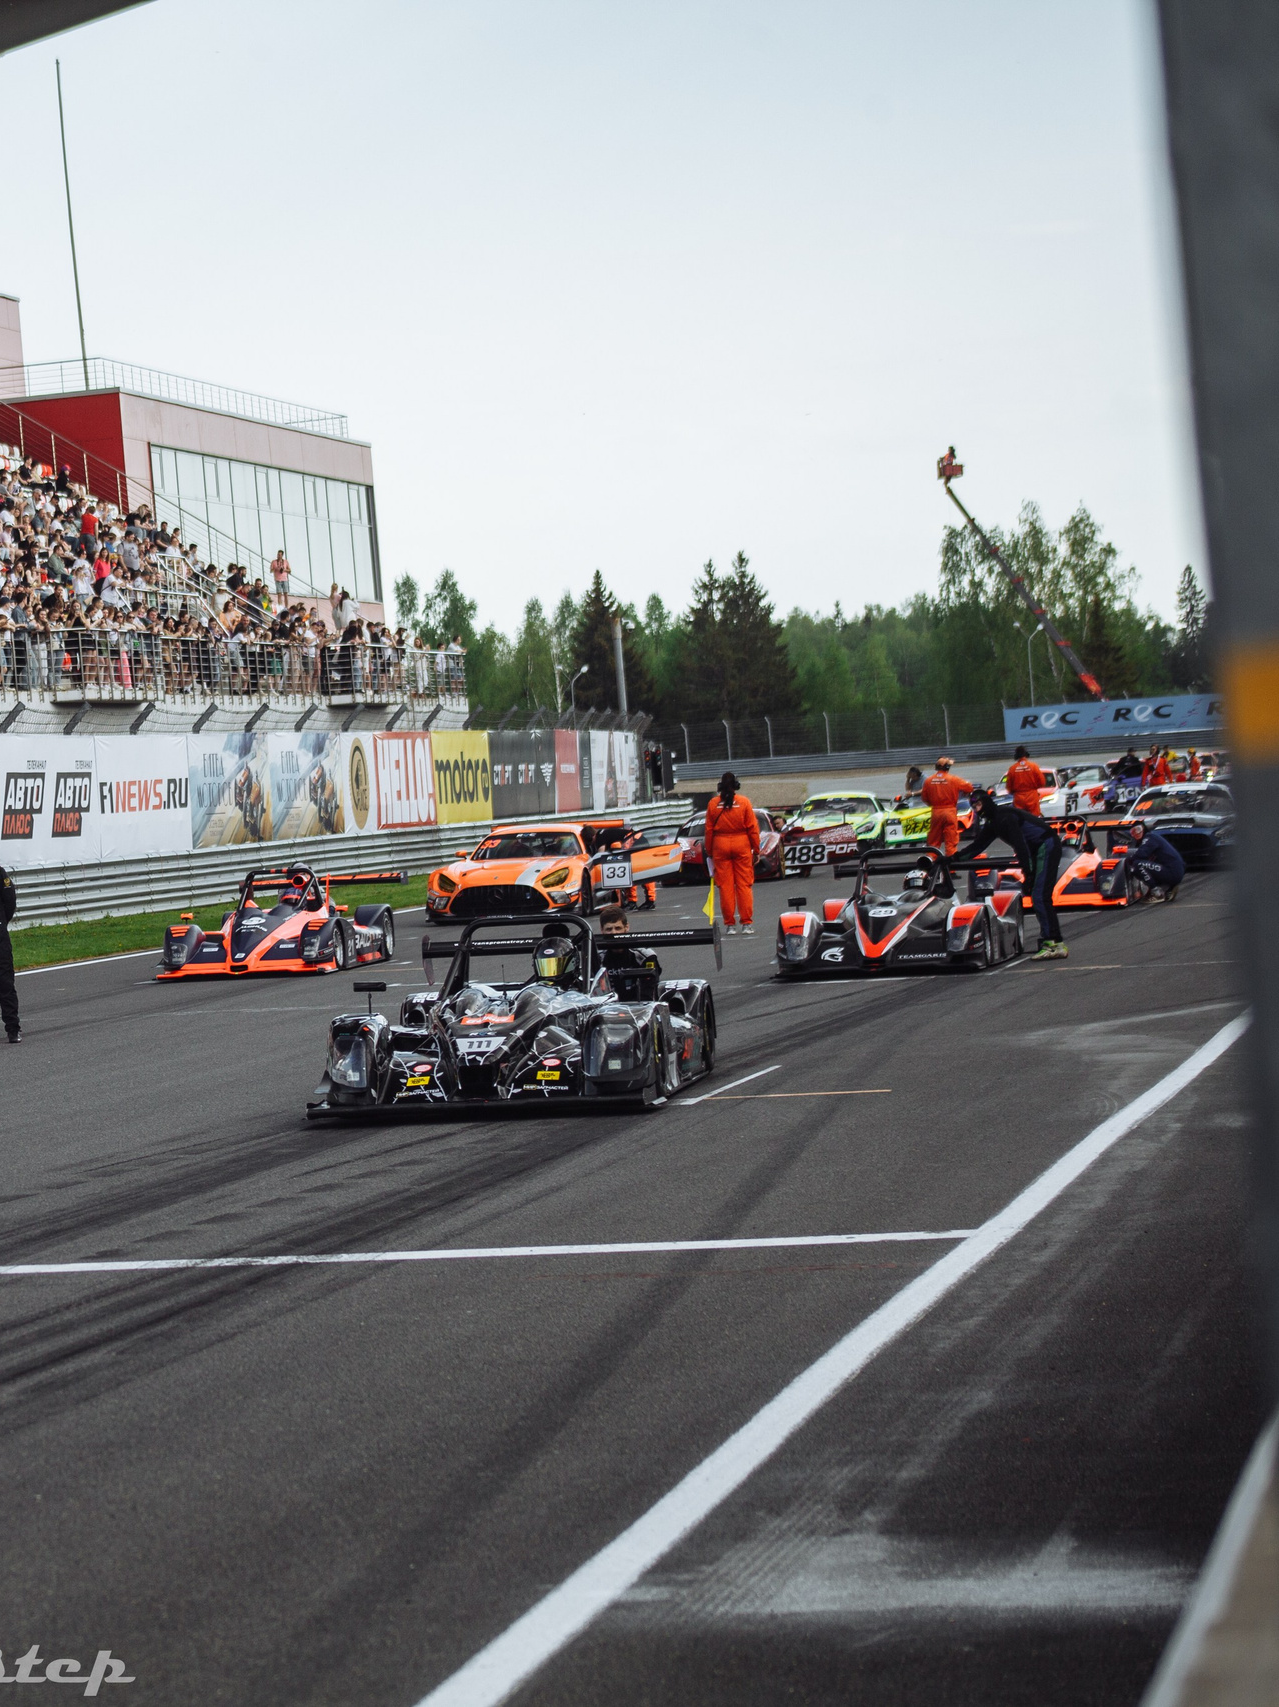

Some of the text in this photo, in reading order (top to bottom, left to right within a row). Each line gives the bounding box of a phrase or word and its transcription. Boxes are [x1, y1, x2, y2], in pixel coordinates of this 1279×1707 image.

[376, 737, 435, 825] HELLO!
[5, 778, 43, 810] АВТО
[55, 777, 90, 809] АВТО
[99, 777, 189, 814] F1NEWS.RU
[3, 814, 31, 834] ПЛЮС
[54, 812, 80, 832] ПЛЮС
[889, 828, 898, 836] 4
[784, 844, 826, 865] 488
[606, 866, 627, 879] 33
[347, 939, 355, 957] 21
